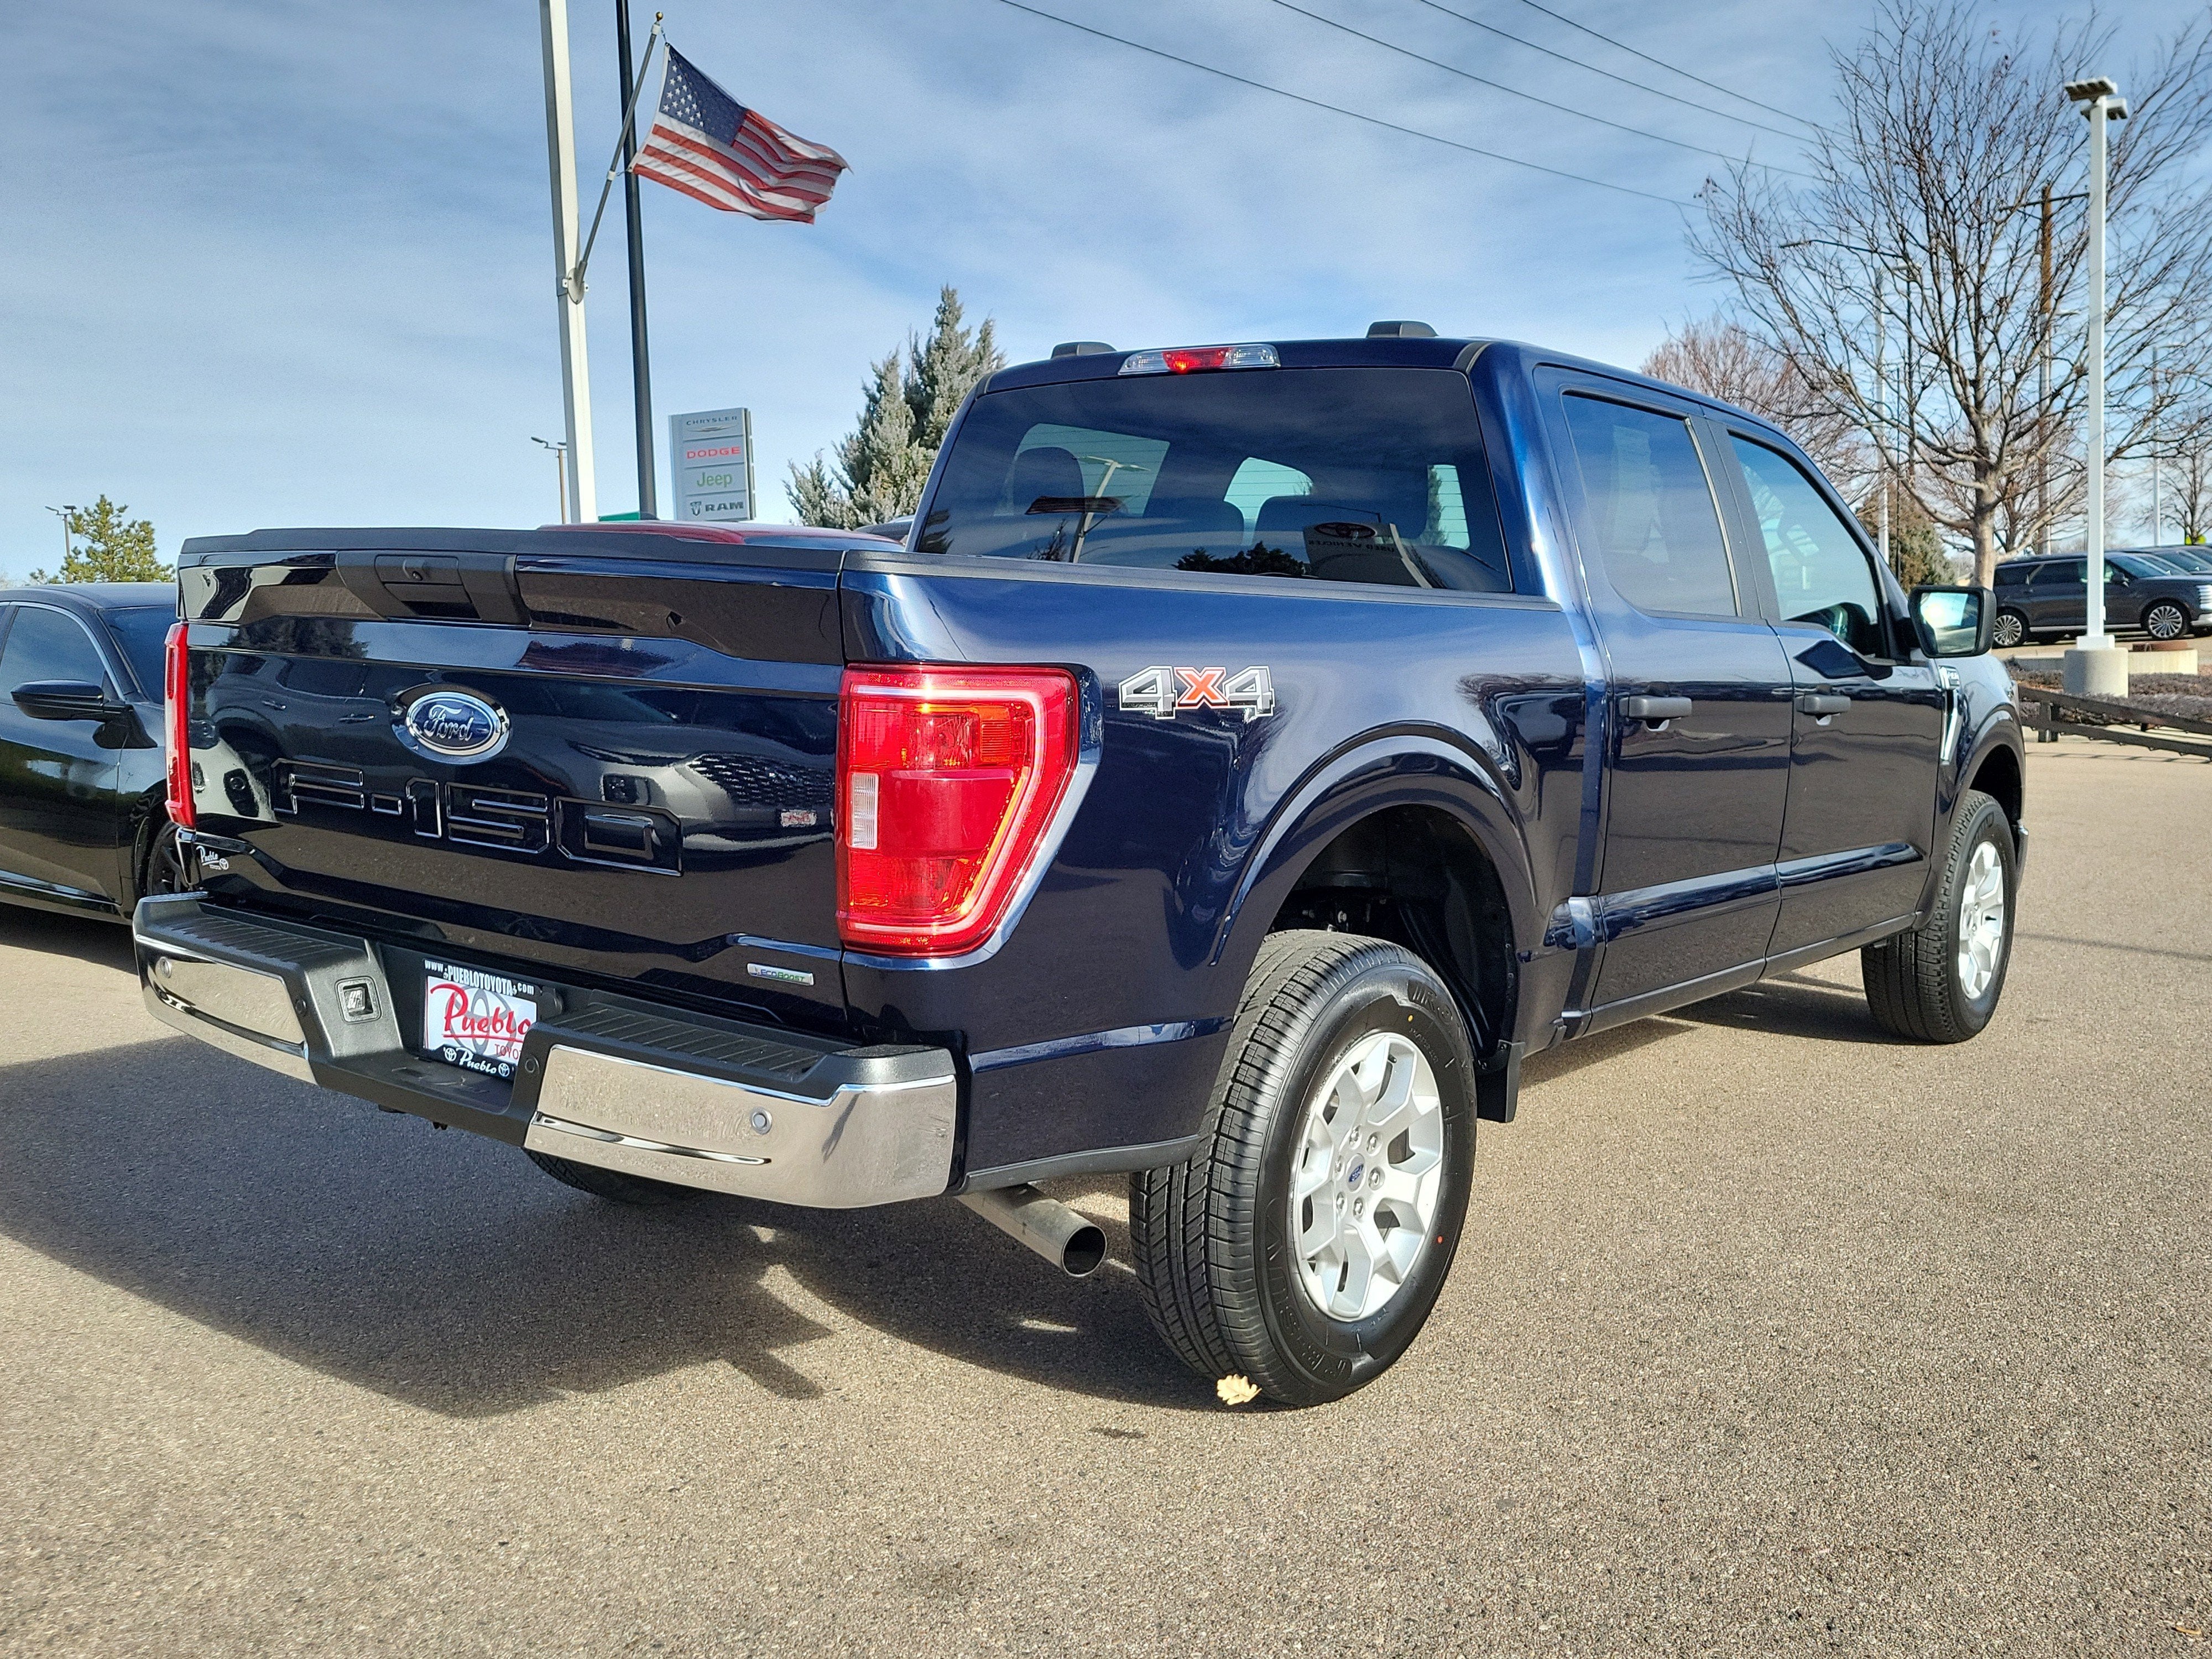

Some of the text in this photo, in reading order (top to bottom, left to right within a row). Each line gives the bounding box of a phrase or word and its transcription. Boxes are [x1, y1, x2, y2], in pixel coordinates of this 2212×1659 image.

[686, 416, 738, 426] CHRYSLER
[687, 446, 741, 459] DODGE
[697, 472, 733, 488] Jeep
[705, 501, 744, 512] RAM
[424, 704, 474, 741] Ford
[271, 758, 684, 878] F-150
[430, 983, 531, 1035] Pueblo
[495, 1044, 522, 1060] TOYO
[456, 1047, 497, 1074] Pueblo
